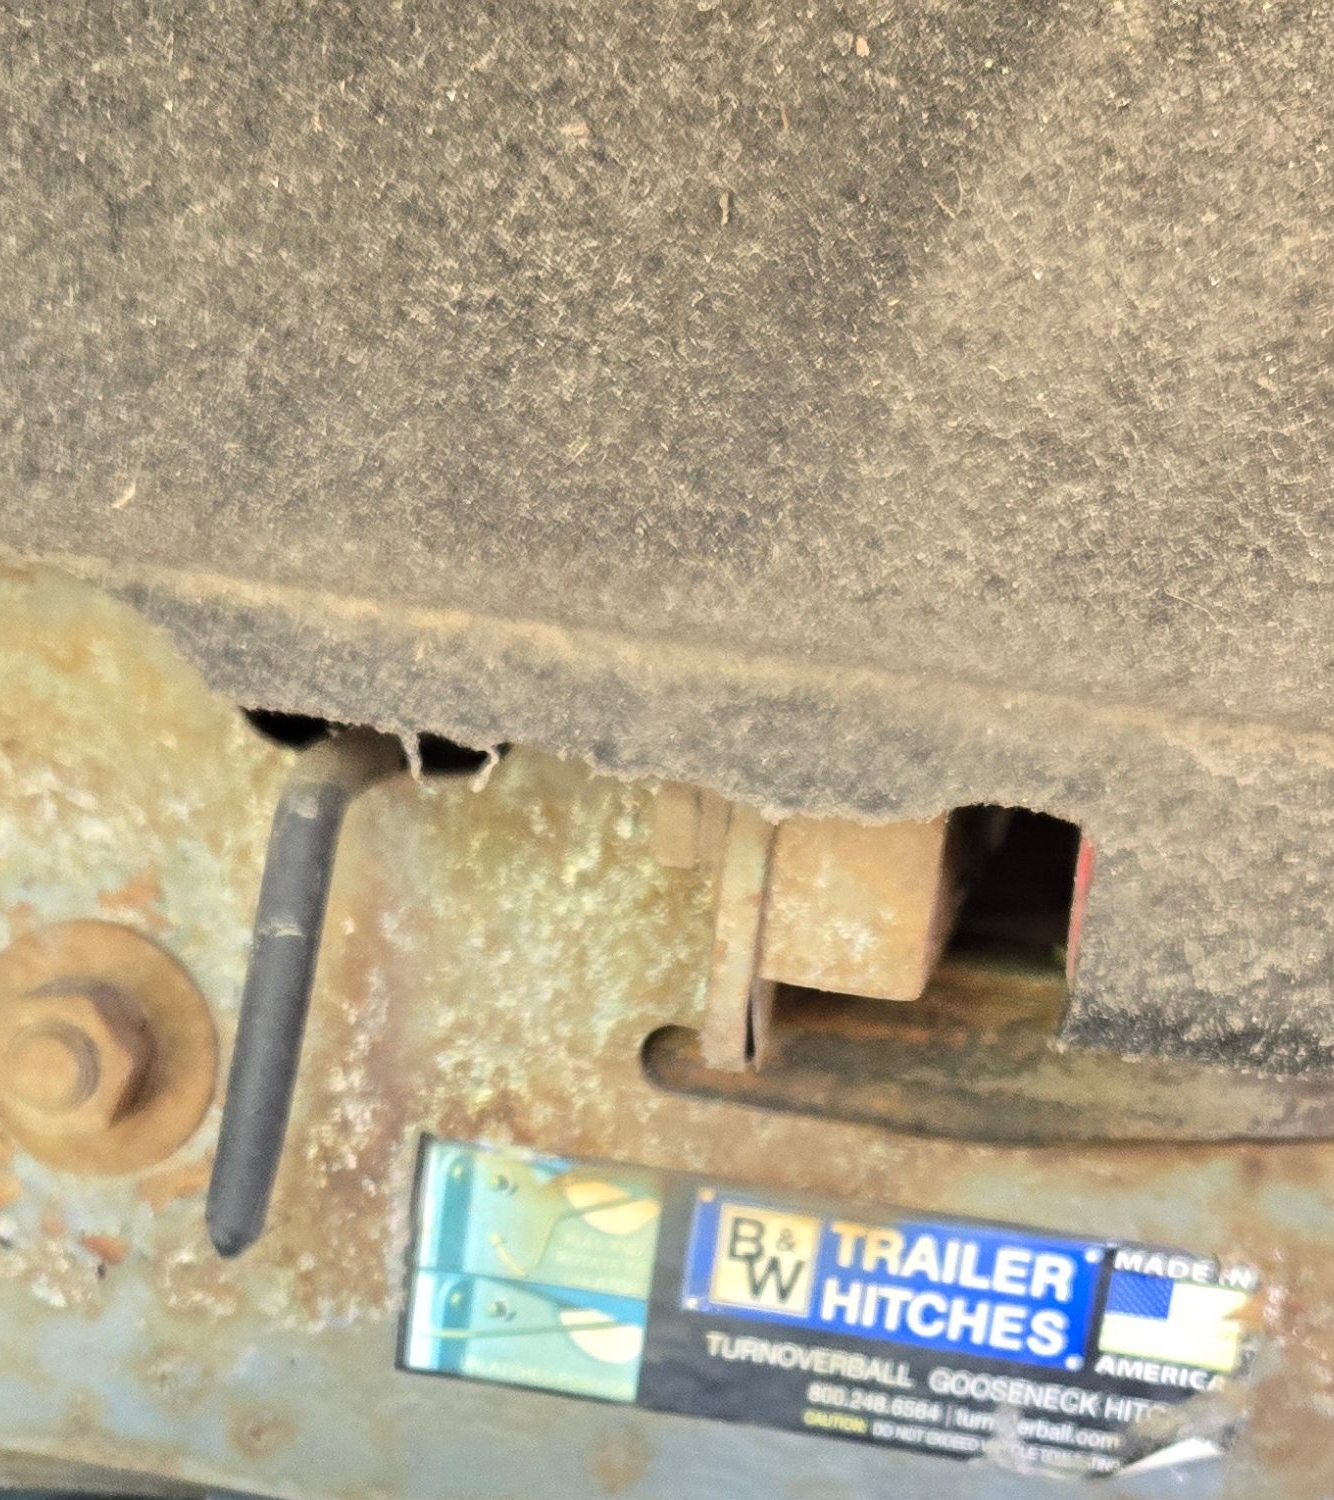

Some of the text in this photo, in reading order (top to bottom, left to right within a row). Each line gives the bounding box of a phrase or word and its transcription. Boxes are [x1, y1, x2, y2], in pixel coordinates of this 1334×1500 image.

[831, 1219, 1075, 1302] TRAILER
[1114, 1251, 1216, 1284] MADE
[821, 1279, 1069, 1357] HITCHES
[705, 1331, 1171, 1423] TURNOVERBALL GOOSENECK HITC
[1094, 1353, 1226, 1392] AMERICA
[954, 1405, 1123, 1449] turnerball.com
